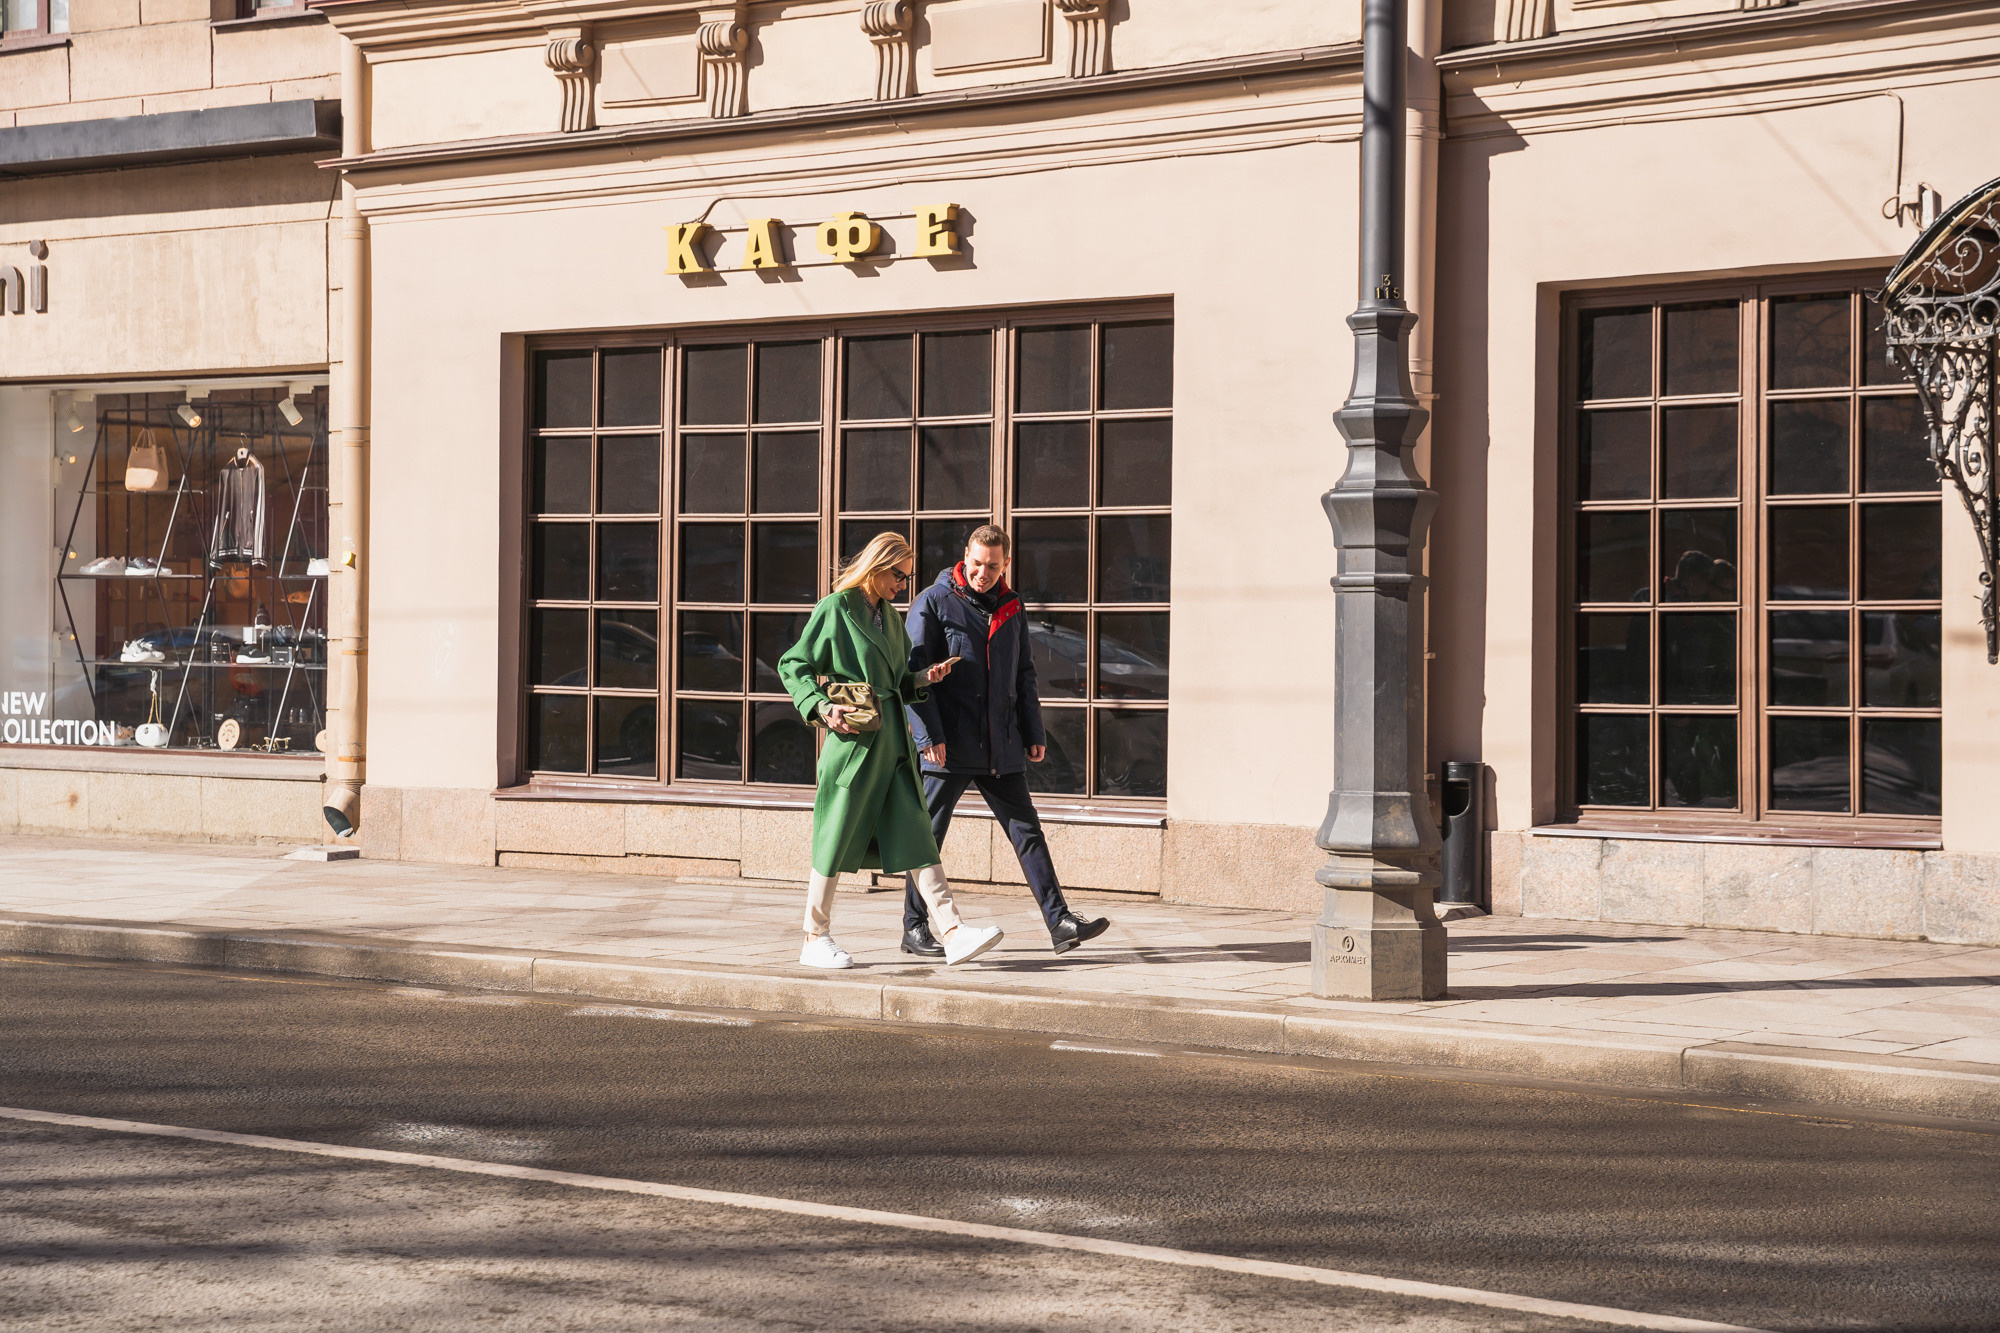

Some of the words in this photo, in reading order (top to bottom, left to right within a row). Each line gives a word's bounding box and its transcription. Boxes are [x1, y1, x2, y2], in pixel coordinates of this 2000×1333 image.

[663, 203, 962, 275] КАФЕ
[1376, 287, 1400, 299] 115
[0, 718, 116, 746] OLLECTION
